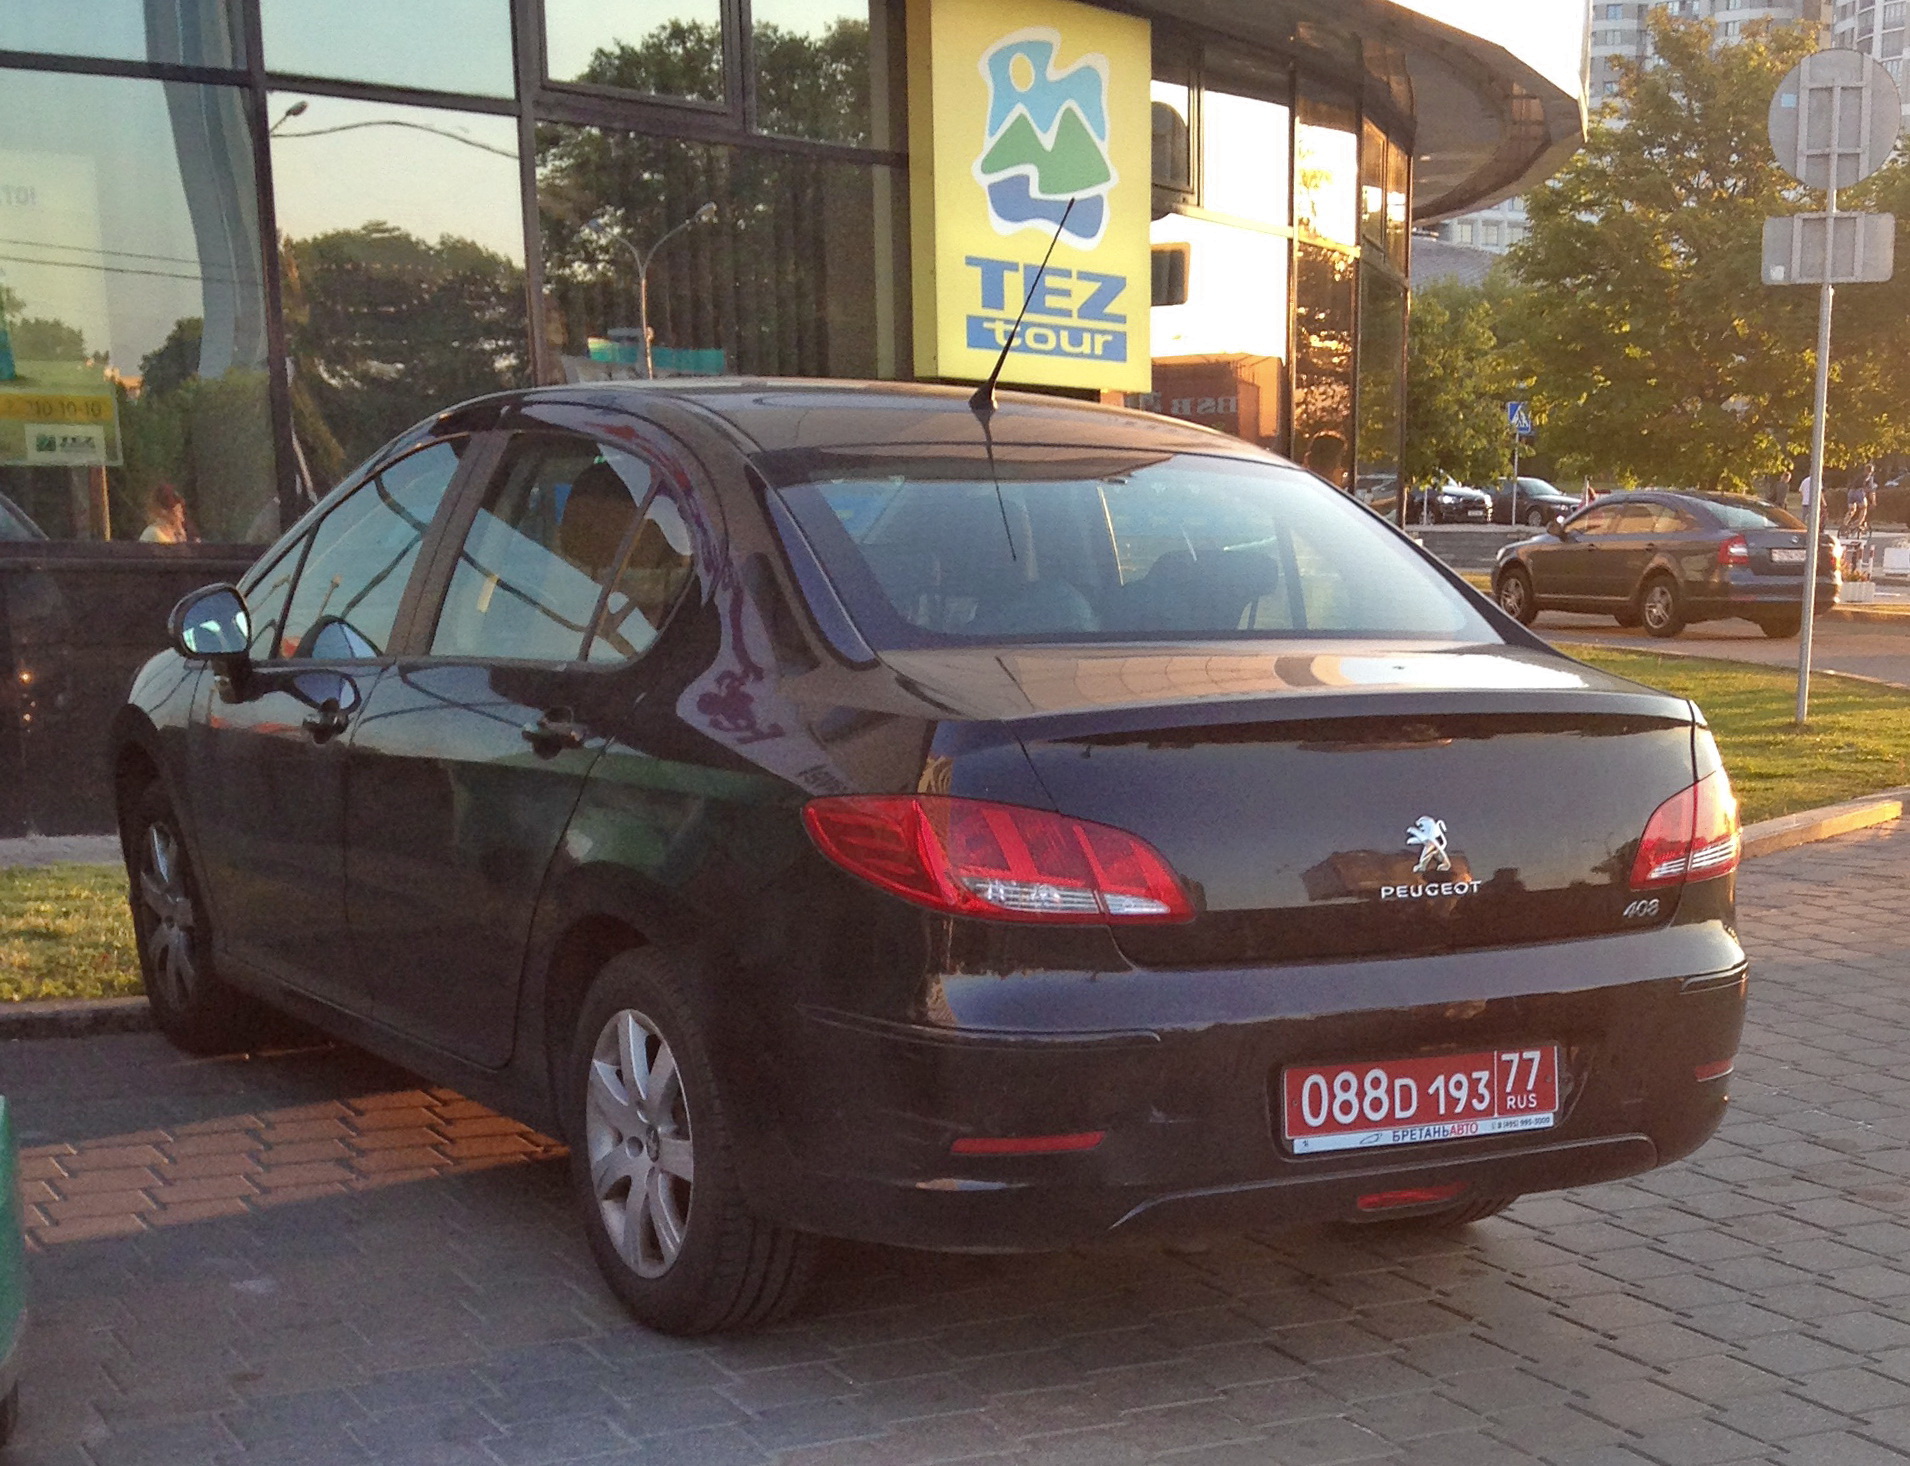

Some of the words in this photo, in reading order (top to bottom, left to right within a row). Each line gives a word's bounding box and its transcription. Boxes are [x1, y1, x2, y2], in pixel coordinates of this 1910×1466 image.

[965, 255, 1127, 324] TEZ
[983, 319, 1113, 355] tour
[1380, 880, 1482, 899] PEUGEOT
[1622, 898, 1660, 918] 408
[1302, 1068, 1418, 1128] 088D
[1427, 1070, 1491, 1116] 193
[1501, 1050, 1541, 1093] 77
[1506, 1093, 1538, 1110] RUS
